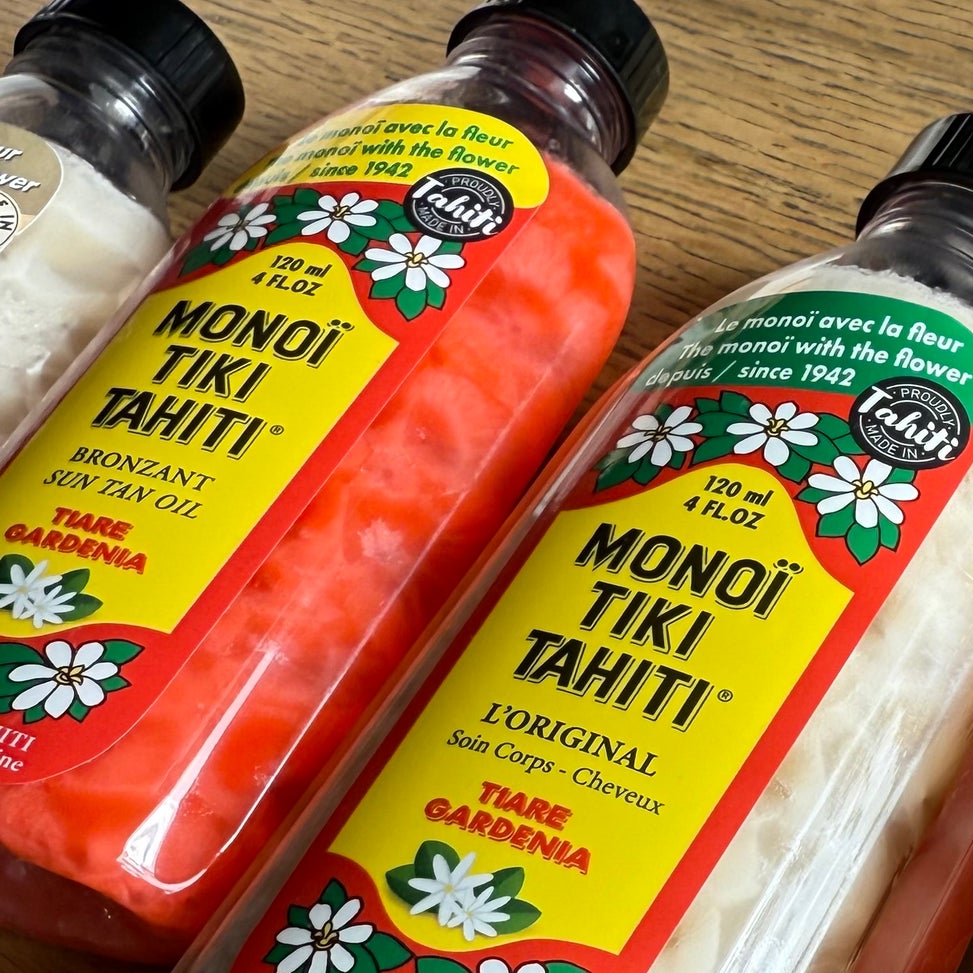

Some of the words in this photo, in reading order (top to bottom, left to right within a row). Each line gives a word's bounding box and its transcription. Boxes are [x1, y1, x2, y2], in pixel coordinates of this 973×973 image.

[361, 139, 405, 157] with
[408, 141, 443, 159] the
[447, 145, 519, 176] flower
[383, 122, 434, 136] avec
[436, 120, 457, 138] la
[461, 124, 514, 150] fleur
[310, 162, 358, 178] since
[364, 160, 413, 178] 1942
[412, 176, 502, 236] Tahiti
[451, 177, 500, 207] PROUDLY
[449, 225, 464, 234] IN
[251, 271, 268, 286] 4
[270, 254, 305, 272] 120
[305, 263, 332, 279] ml
[152, 299, 355, 369] MONOÏ
[714, 317, 740, 336] Le
[741, 310, 820, 330] monoï
[819, 315, 876, 334] avec
[879, 315, 902, 338] la
[907, 322, 965, 354] fleur
[152, 344, 272, 403] TIKI
[645, 363, 713, 390] depuis
[738, 362, 793, 381] since
[800, 363, 856, 387] 1942
[679, 341, 713, 360] The
[717, 335, 796, 356] monoï
[797, 336, 848, 358] with
[851, 339, 889, 364] the
[893, 347, 973, 386] flower
[858, 385, 959, 461] Tahiti
[900, 388, 956, 426] PROUDLY
[866, 424, 899, 455] MADE
[902, 447, 918, 459] IN
[69, 446, 216, 492] BRONZANT
[703, 474, 743, 499] 120
[742, 488, 775, 508] ml
[43, 468, 100, 491] SUN
[97, 478, 156, 504] TAN
[154, 493, 203, 519] OIL
[683, 494, 701, 512] 4
[701, 499, 767, 531] FL.OZ
[50, 506, 134, 542] TIARE
[4, 523, 148, 575] GARDENIA
[574, 522, 804, 620] MONOÏ
[579, 580, 715, 661] TIKI
[481, 702, 658, 777] L'ORIGINAL
[447, 729, 490, 755] Soin
[494, 742, 555, 775] Corps
[572, 767, 665, 816] Cheveux
[478, 780, 573, 831] TIARE
[424, 797, 592, 876] GARDENIA
